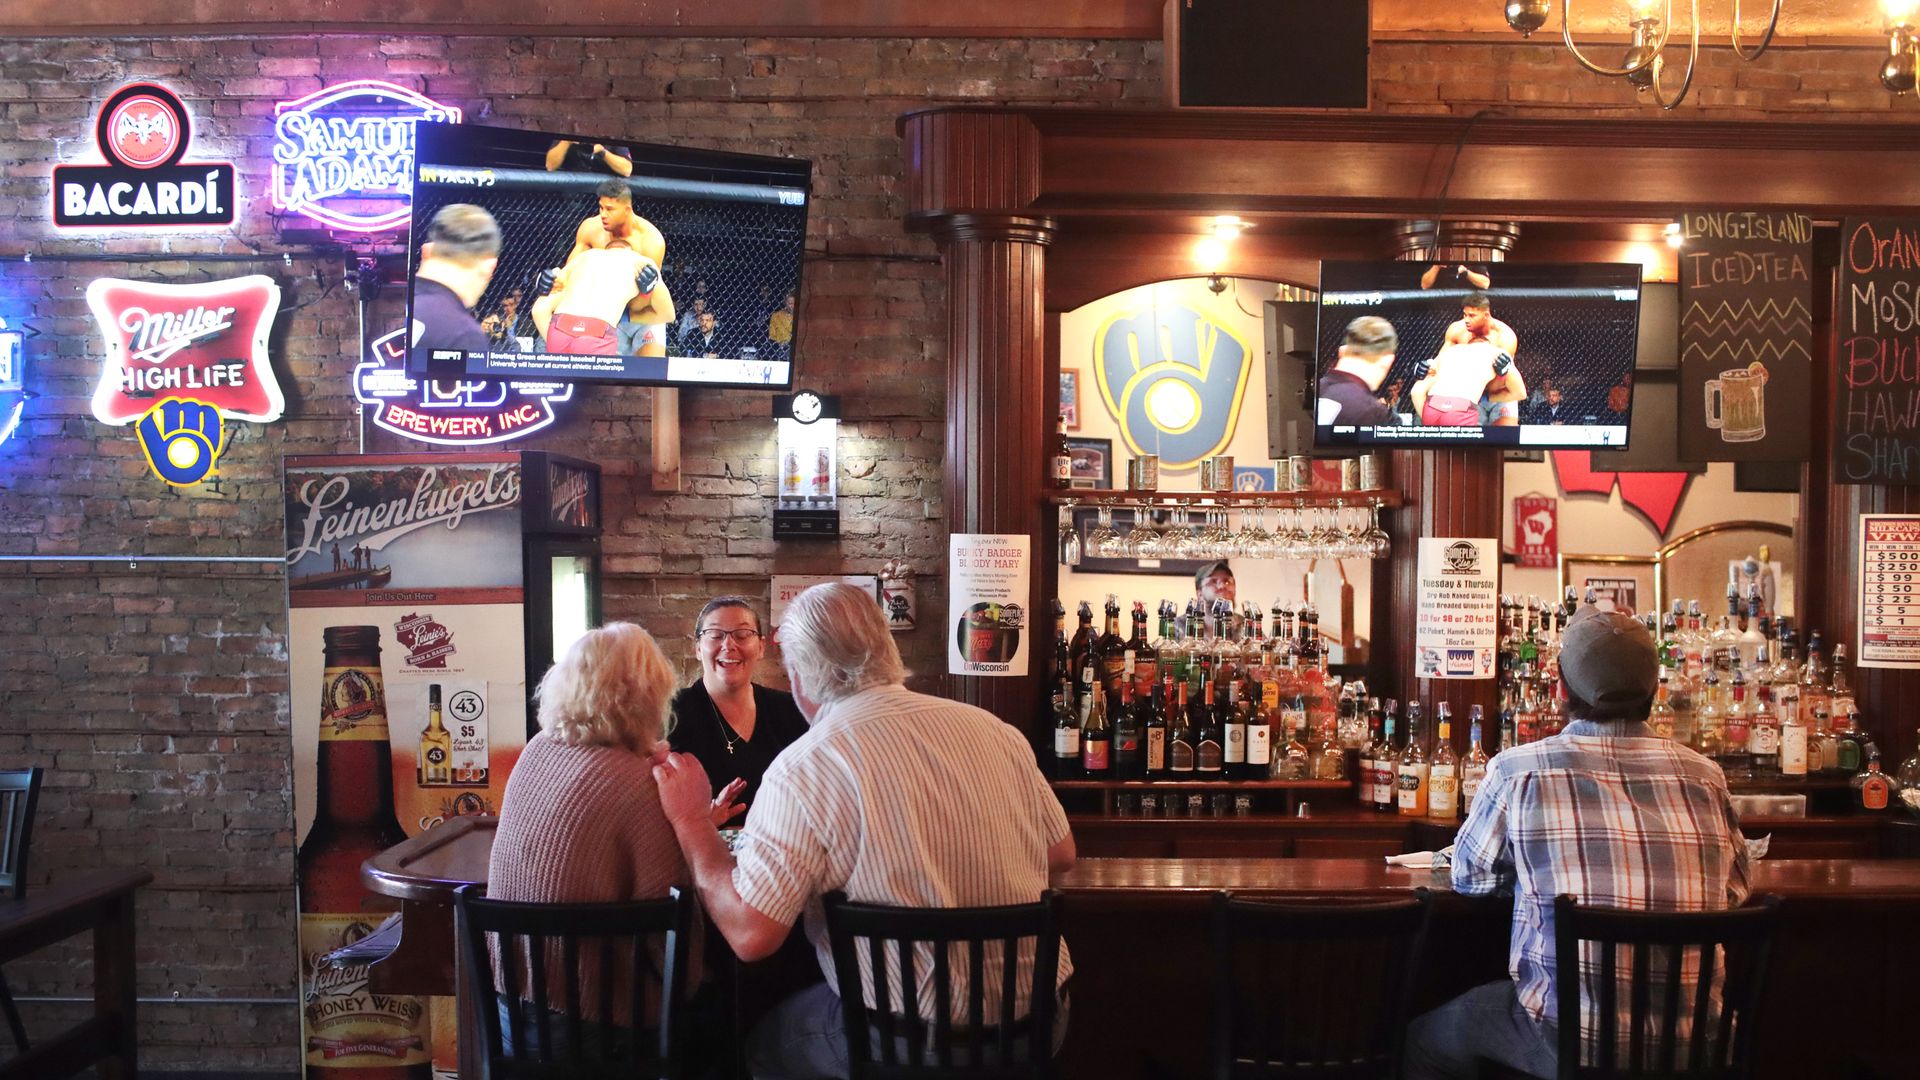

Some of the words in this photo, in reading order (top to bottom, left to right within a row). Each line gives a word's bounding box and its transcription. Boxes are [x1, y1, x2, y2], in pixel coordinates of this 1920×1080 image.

[439, 168, 474, 184] PACK
[1754, 252, 1809, 284] TEA
[119, 305, 236, 352] Miller
[433, 350, 461, 360] ESPN
[490, 352, 516, 361] Bowling
[517, 353, 536, 361] Green
[537, 354, 569, 362] eliminates
[570, 355, 595, 363] baseball
[596, 357, 623, 365] program
[490, 360, 517, 369] University
[1845, 336, 1920, 389] BUC
[117, 366, 181, 392] HIGH
[186, 363, 245, 389] LIFE
[386, 404, 492, 437] BREWERY,
[498, 403, 540, 430] INC.
[987, 549, 1022, 558] BADGER
[994, 560, 1020, 568] MARY
[1423, 579, 1455, 589] Tuesday
[1456, 579, 1462, 588] &
[1465, 580, 1494, 589] Thursday
[366, 592, 382, 601] Join
[384, 592, 395, 600] Us
[396, 592, 412, 600] Out
[1421, 614, 1428, 622] 10
[1431, 614, 1441, 622] for
[1443, 614, 1453, 622] $8
[1465, 614, 1474, 622] 20
[455, 698, 477, 714] 43
[461, 725, 475, 738] $5
[429, 750, 442, 761] 43
[312, 997, 367, 1020] HONEY
[370, 995, 415, 1020] WEISS
